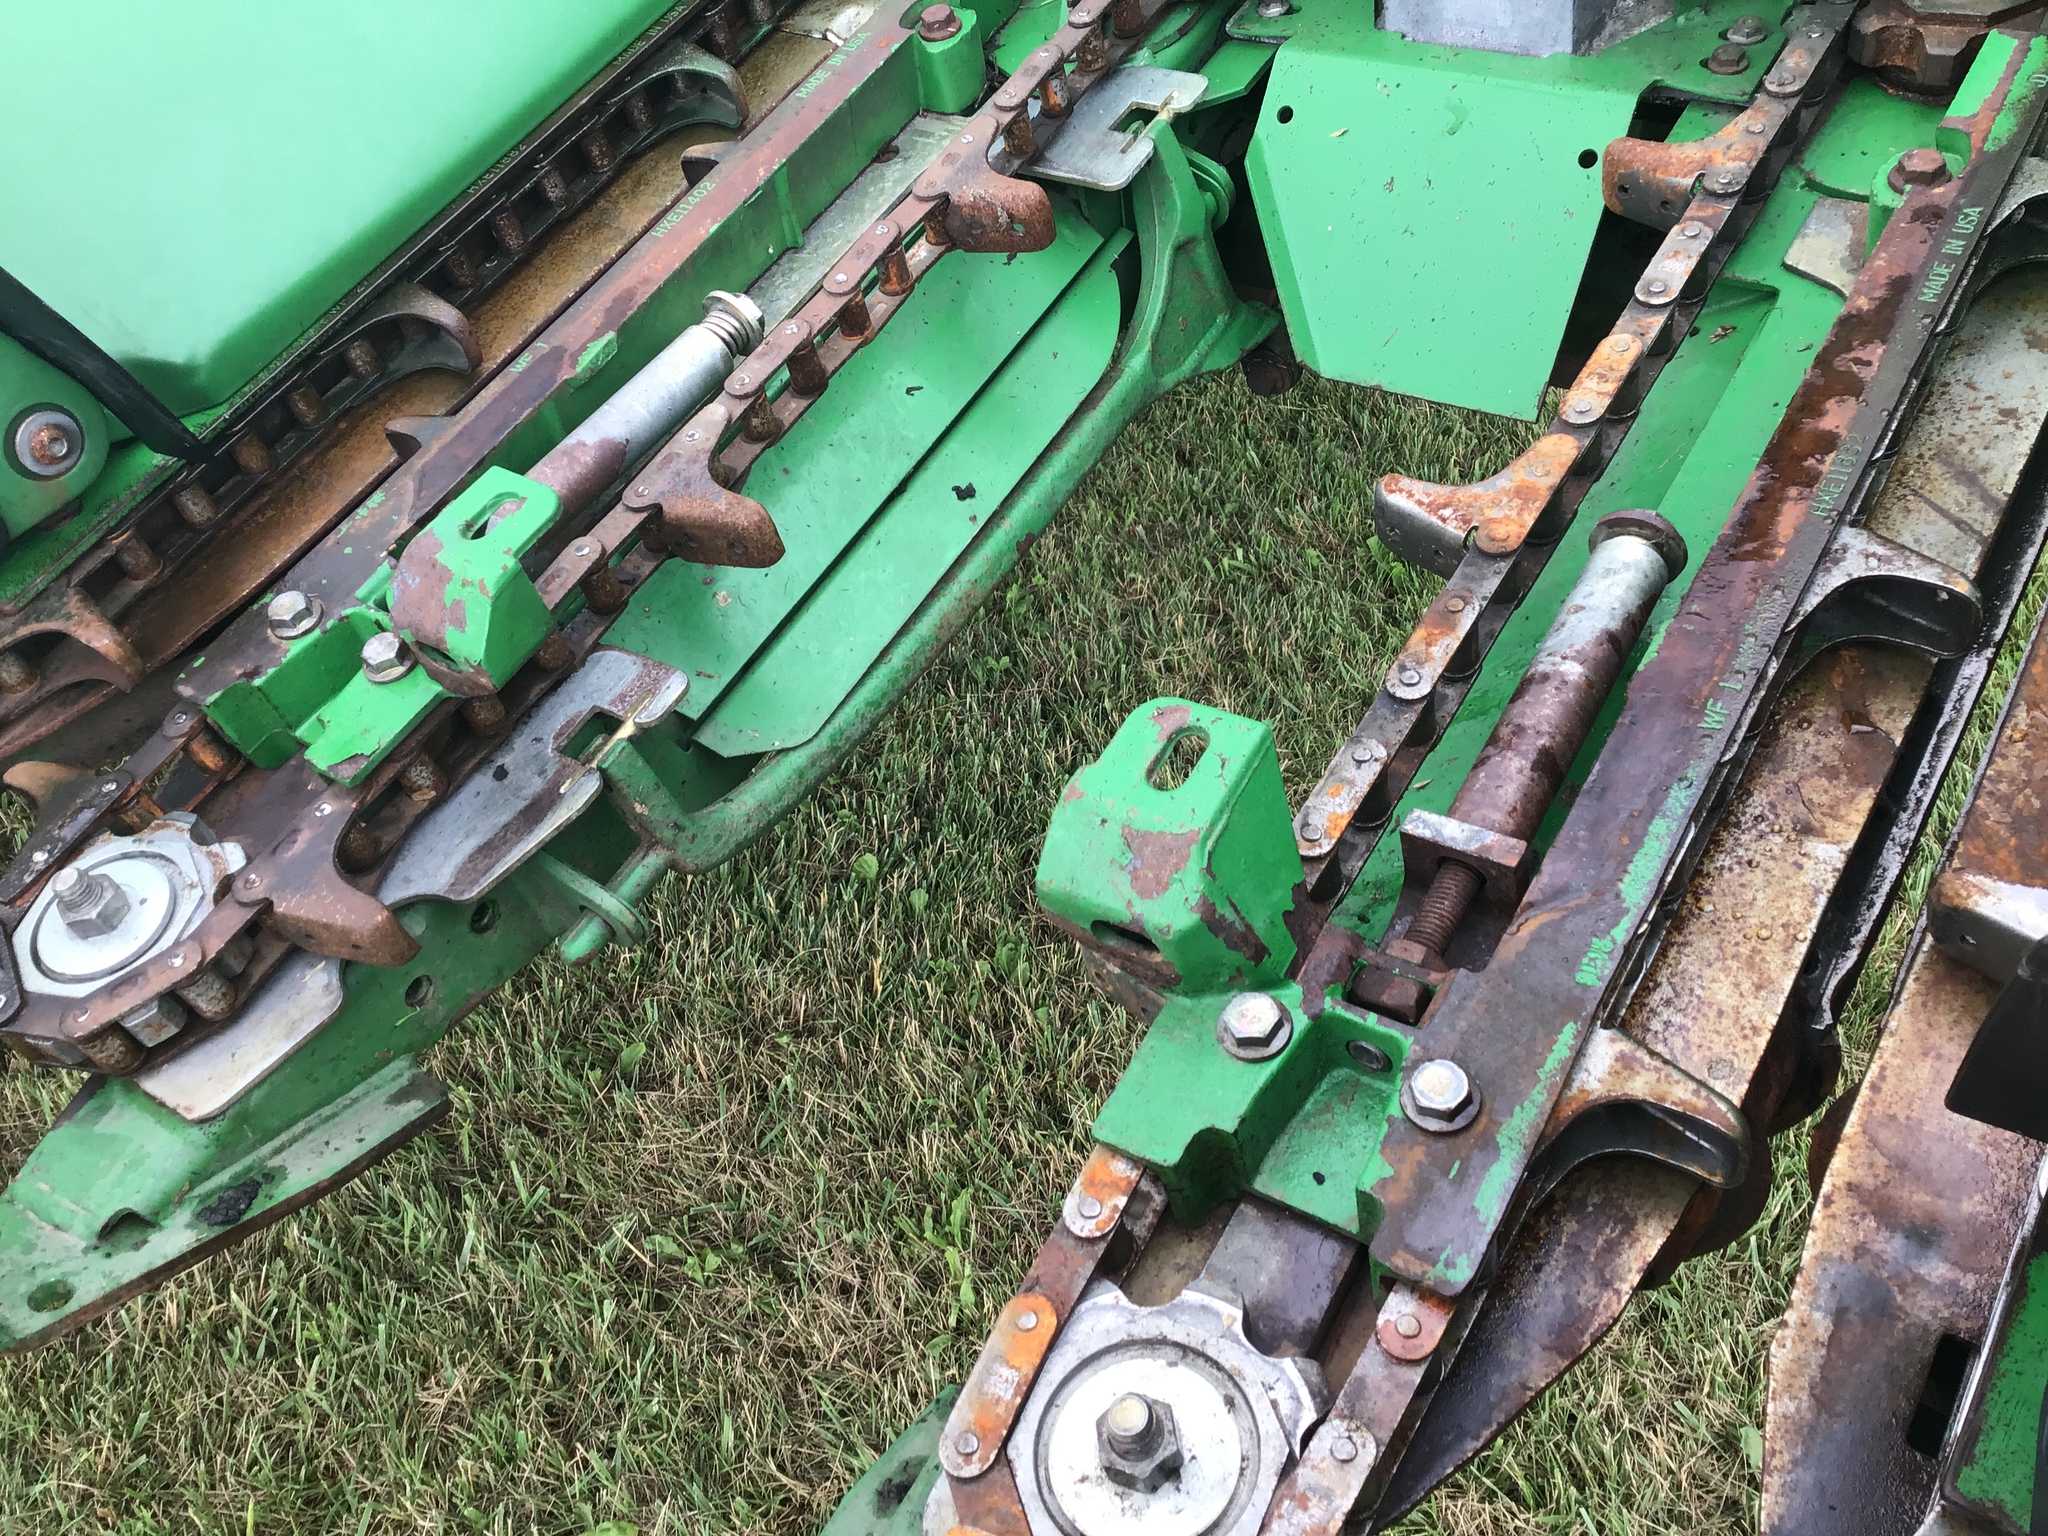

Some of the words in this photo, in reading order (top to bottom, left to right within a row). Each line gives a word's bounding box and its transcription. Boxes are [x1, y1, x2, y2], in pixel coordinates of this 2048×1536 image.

[660, 5, 687, 22] USA
[795, 69, 832, 98] MADE
[827, 54, 847, 66] IN
[842, 32, 871, 51] USA
[651, 181, 717, 238] HXE11402
[1952, 206, 1984, 233] USA
[1941, 238, 1967, 255] IN
[1917, 261, 1956, 303] MADE
[508, 352, 533, 373] WF
[1697, 698, 1730, 730] WF
